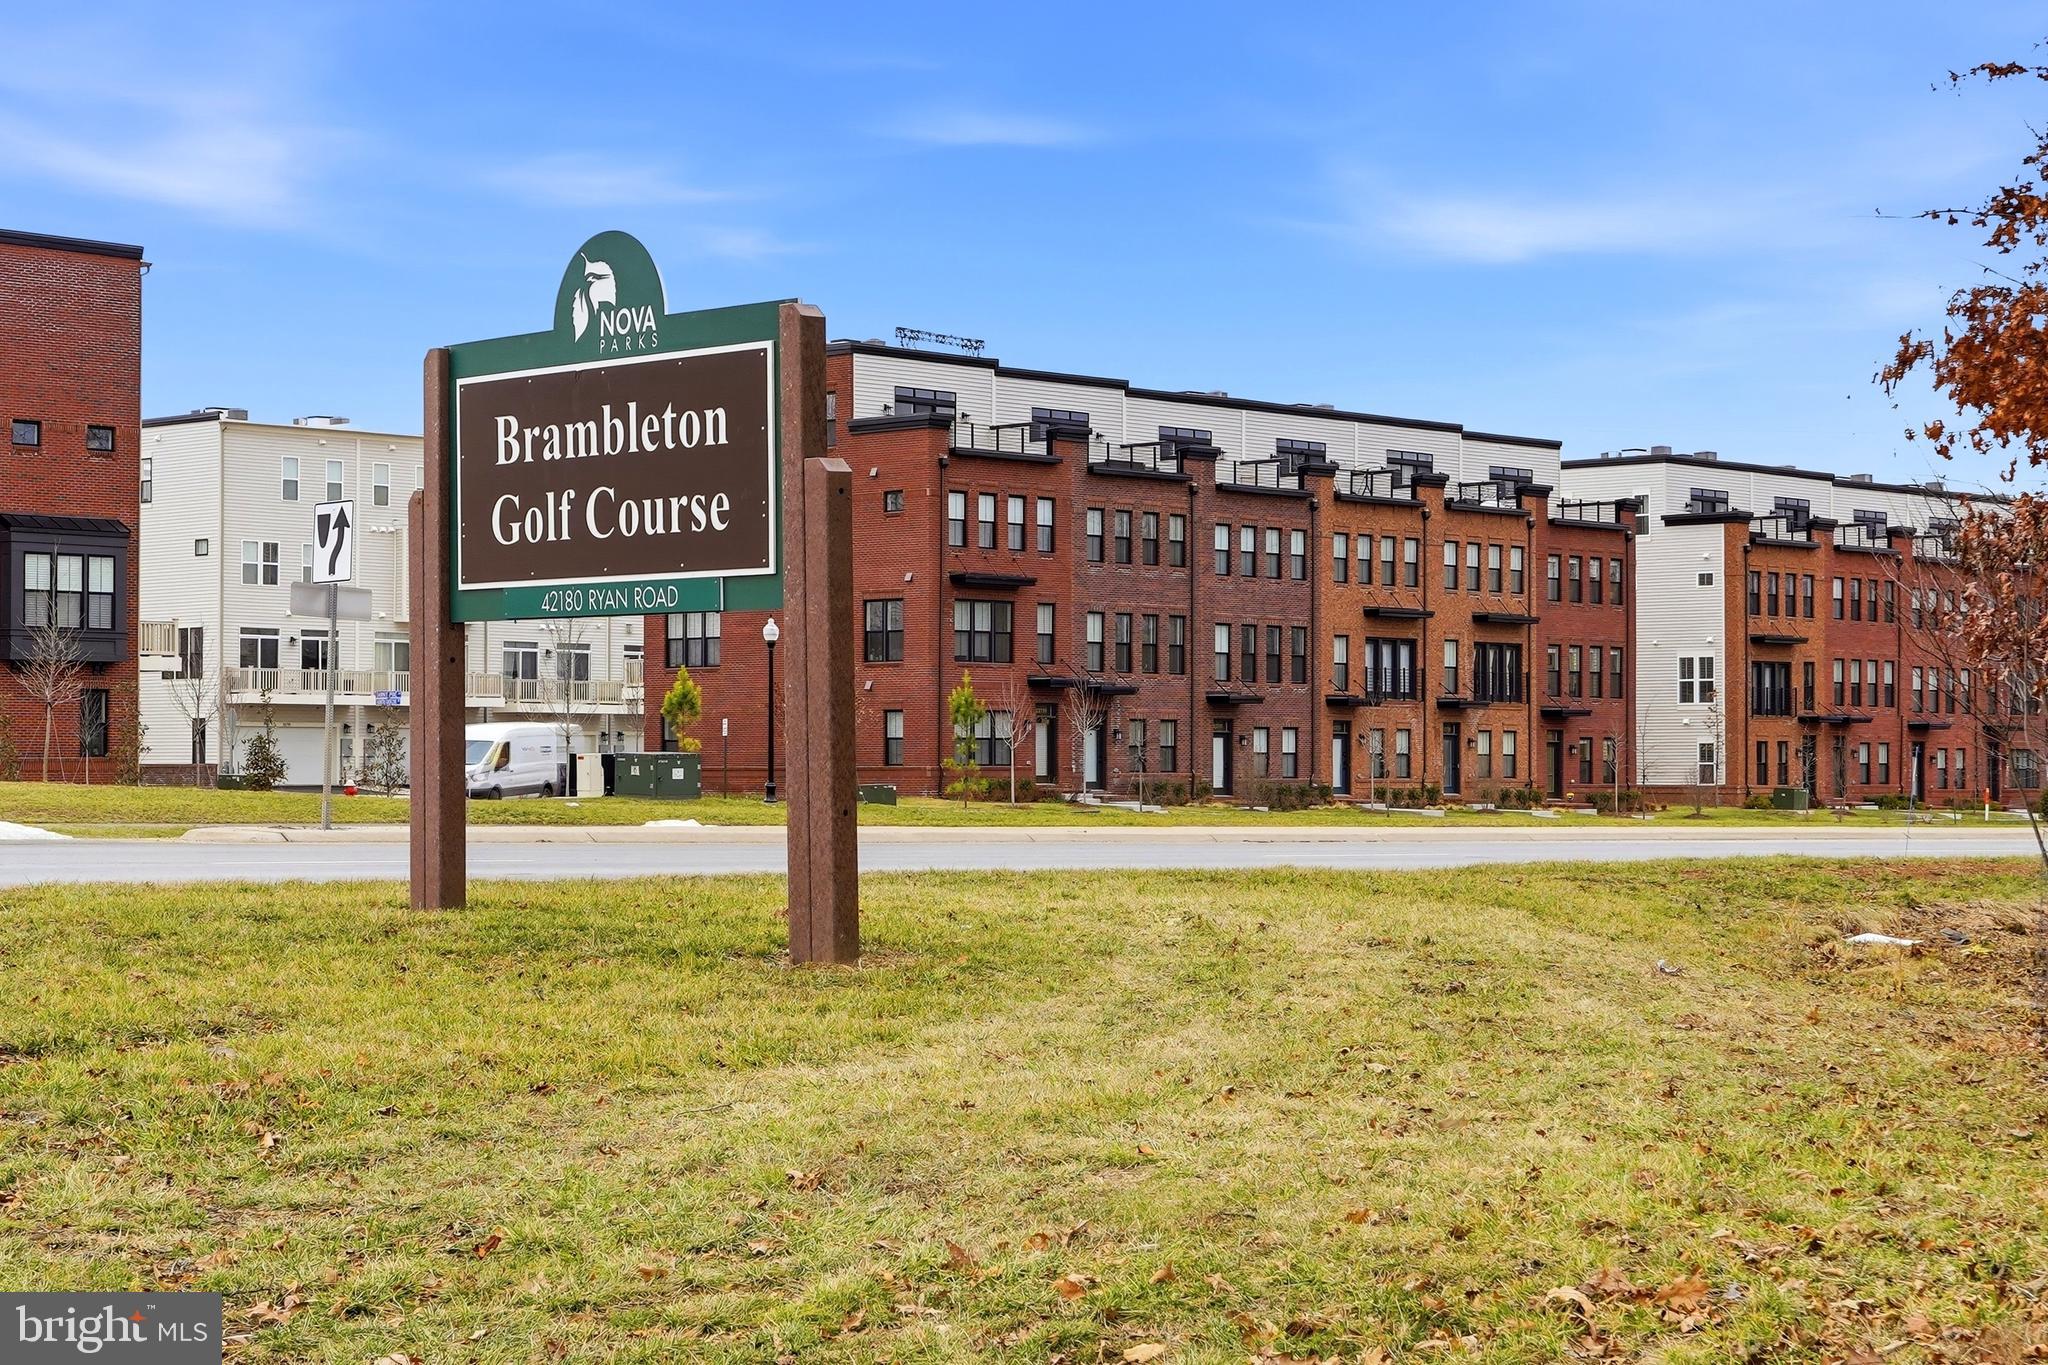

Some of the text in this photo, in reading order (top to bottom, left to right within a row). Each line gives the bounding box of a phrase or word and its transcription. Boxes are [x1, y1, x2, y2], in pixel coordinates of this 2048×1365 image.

[600, 305, 657, 337] NOVA
[600, 333, 658, 354] PARKS
[494, 401, 728, 466] Brambleton
[491, 486, 731, 546] Golf Course
[541, 585, 679, 612] 42180 RYAN ROAD
